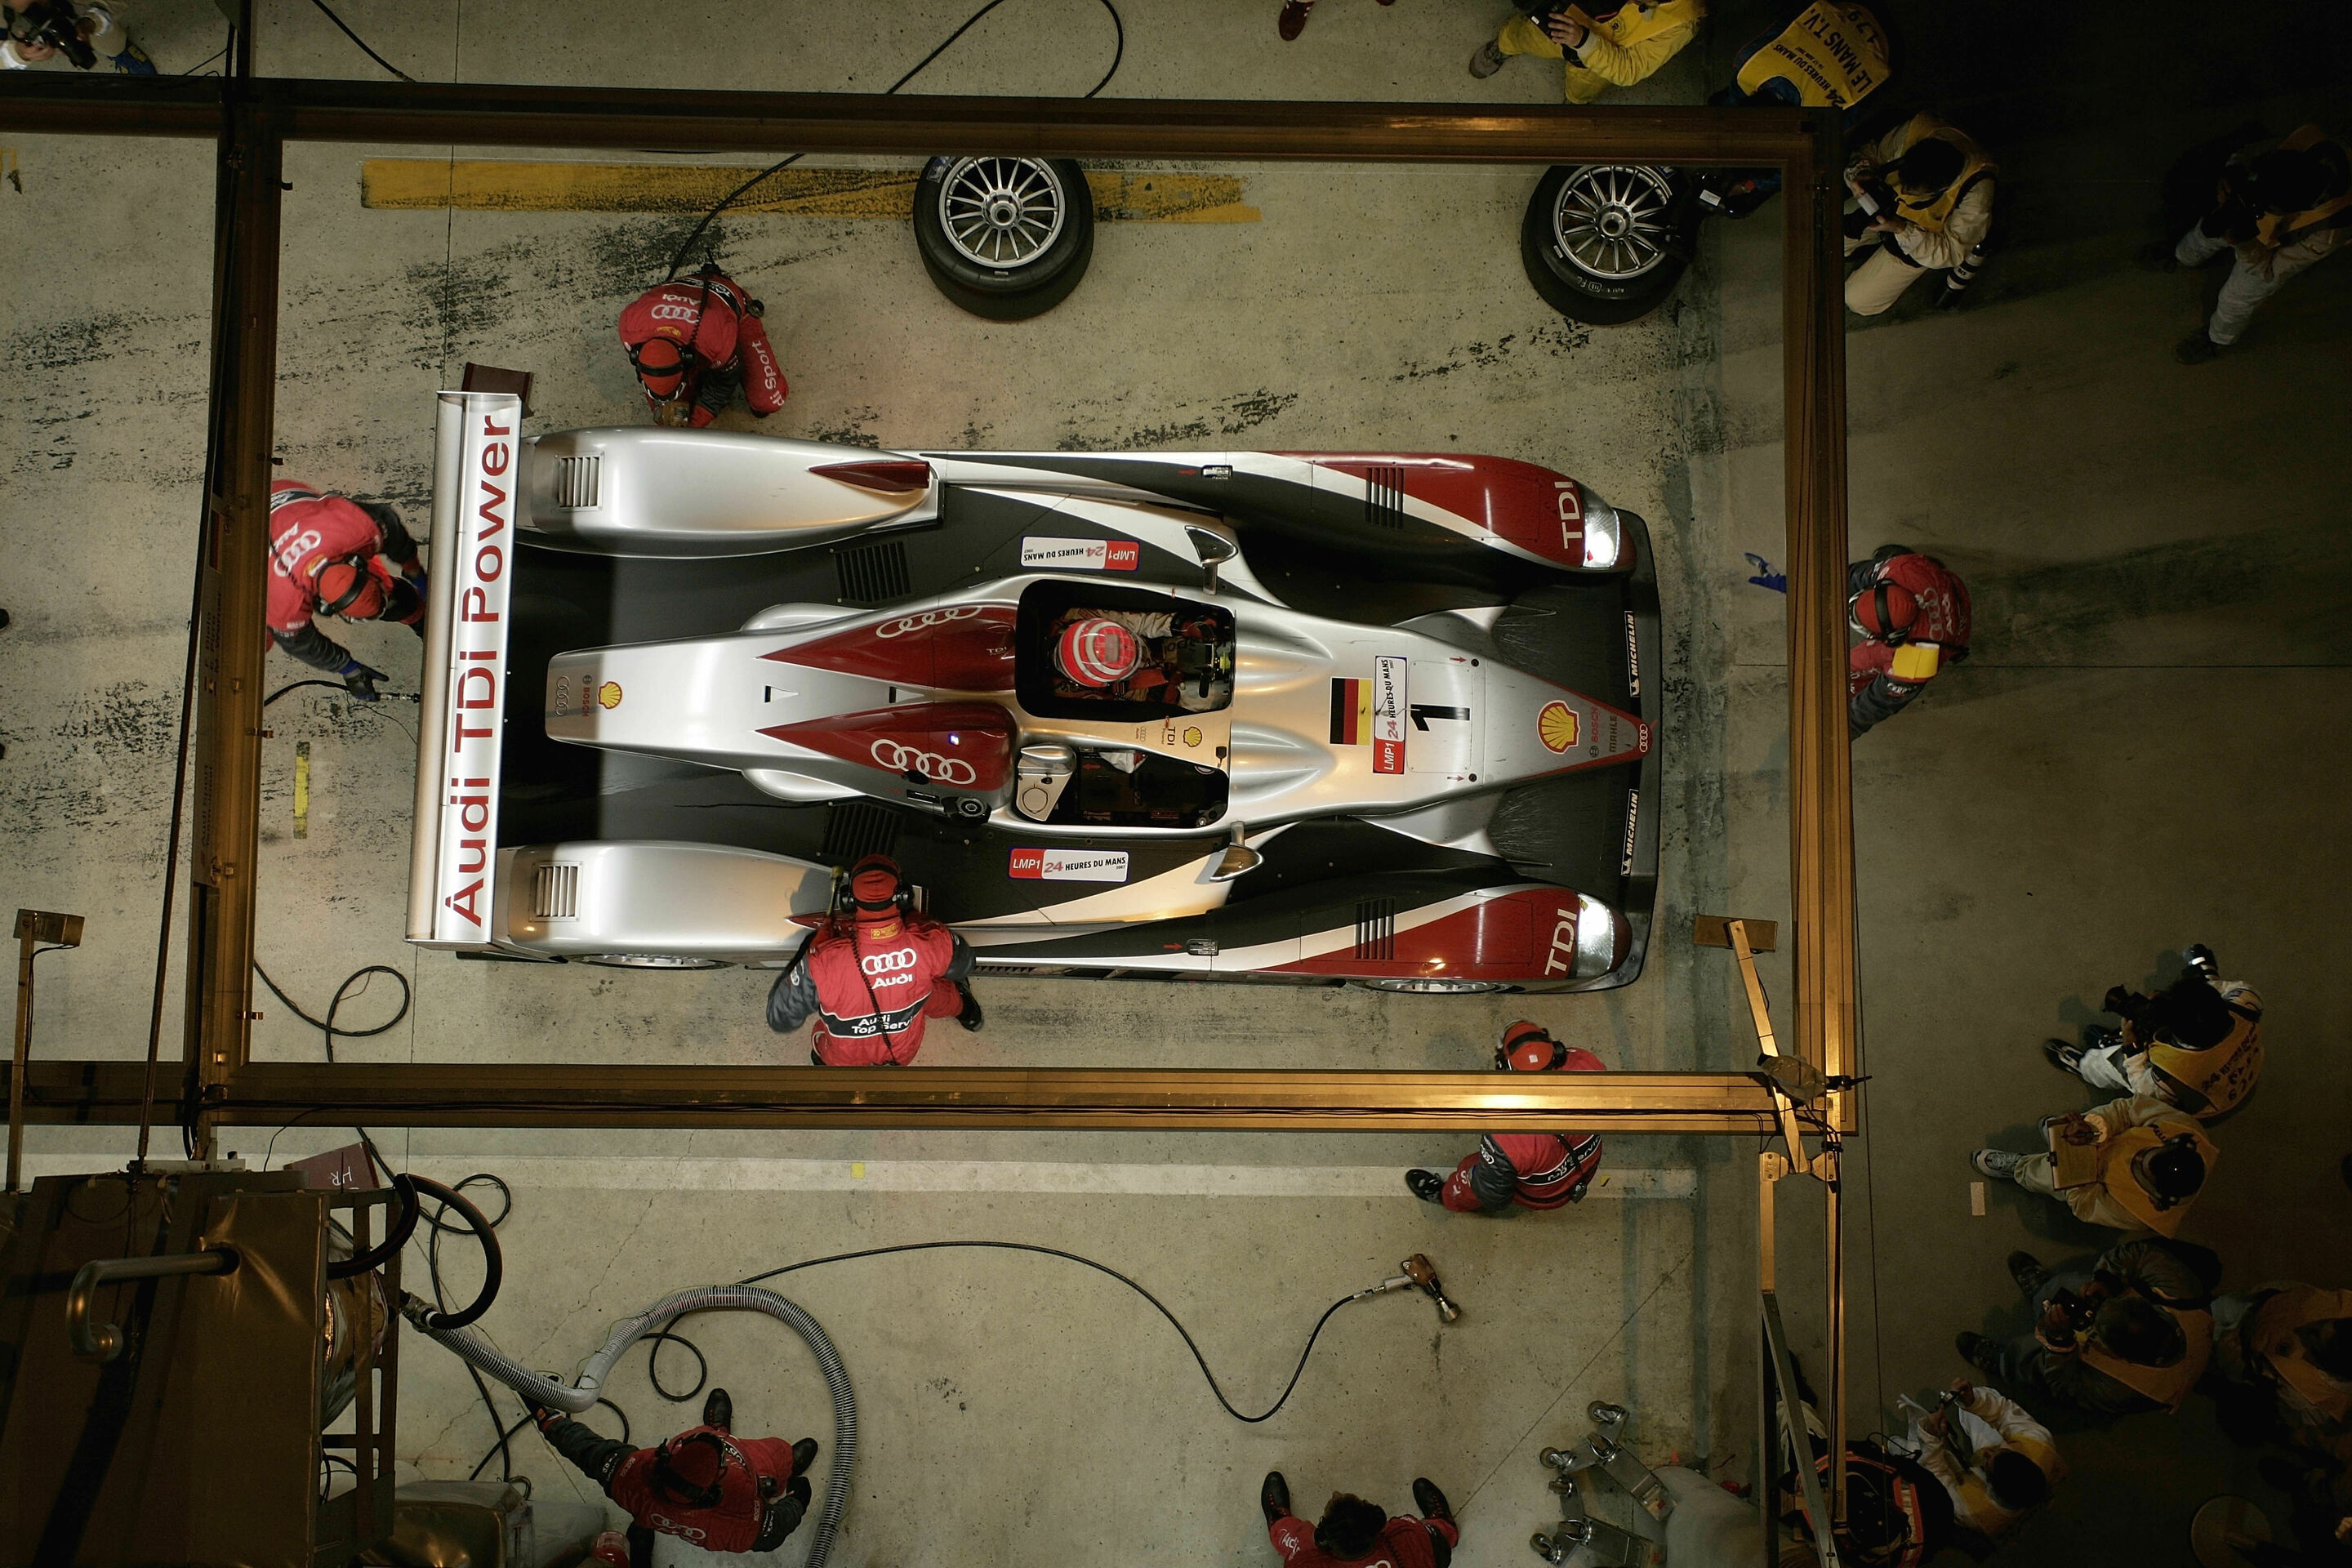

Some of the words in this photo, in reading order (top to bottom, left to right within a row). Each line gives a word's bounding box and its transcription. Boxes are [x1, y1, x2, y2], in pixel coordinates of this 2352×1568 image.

[1773, 44, 1797, 61] MANS
[1793, 56, 1807, 69] DU
[1823, 31, 1862, 75] MANS
[1804, 64, 1831, 91] HEURES
[1851, 69, 1873, 93] LE
[1824, 88, 1847, 107] 24
[752, 340, 776, 390] Sport
[461, 415, 510, 621] Power
[1554, 481, 1583, 550] TDI
[1023, 551, 1045, 561] MANS
[1058, 548, 1084, 557] HEURES
[1085, 546, 1105, 558] 24
[1108, 550, 1136, 561] LMP1
[1628, 614, 1638, 676] MICHELIN
[1381, 659, 1392, 679] MANS
[1385, 681, 1393, 692] DU
[1387, 692, 1396, 719] HEURES
[1410, 704, 1470, 731] 1
[1167, 726, 1176, 746] TDI
[1387, 720, 1398, 740] 24
[1383, 742, 1395, 770] LMP1
[1626, 792, 1638, 856] MICHELIN
[445, 777, 490, 928] Audi
[1013, 859, 1040, 870] LMP1
[1044, 861, 1063, 873] 24
[1065, 861, 1092, 871] HEURES
[1094, 859, 1103, 867] DU
[1105, 857, 1126, 866] MANS
[1544, 908, 1577, 976] TDI
[871, 973, 913, 990] Audi
[851, 1025, 876, 1034] Top
